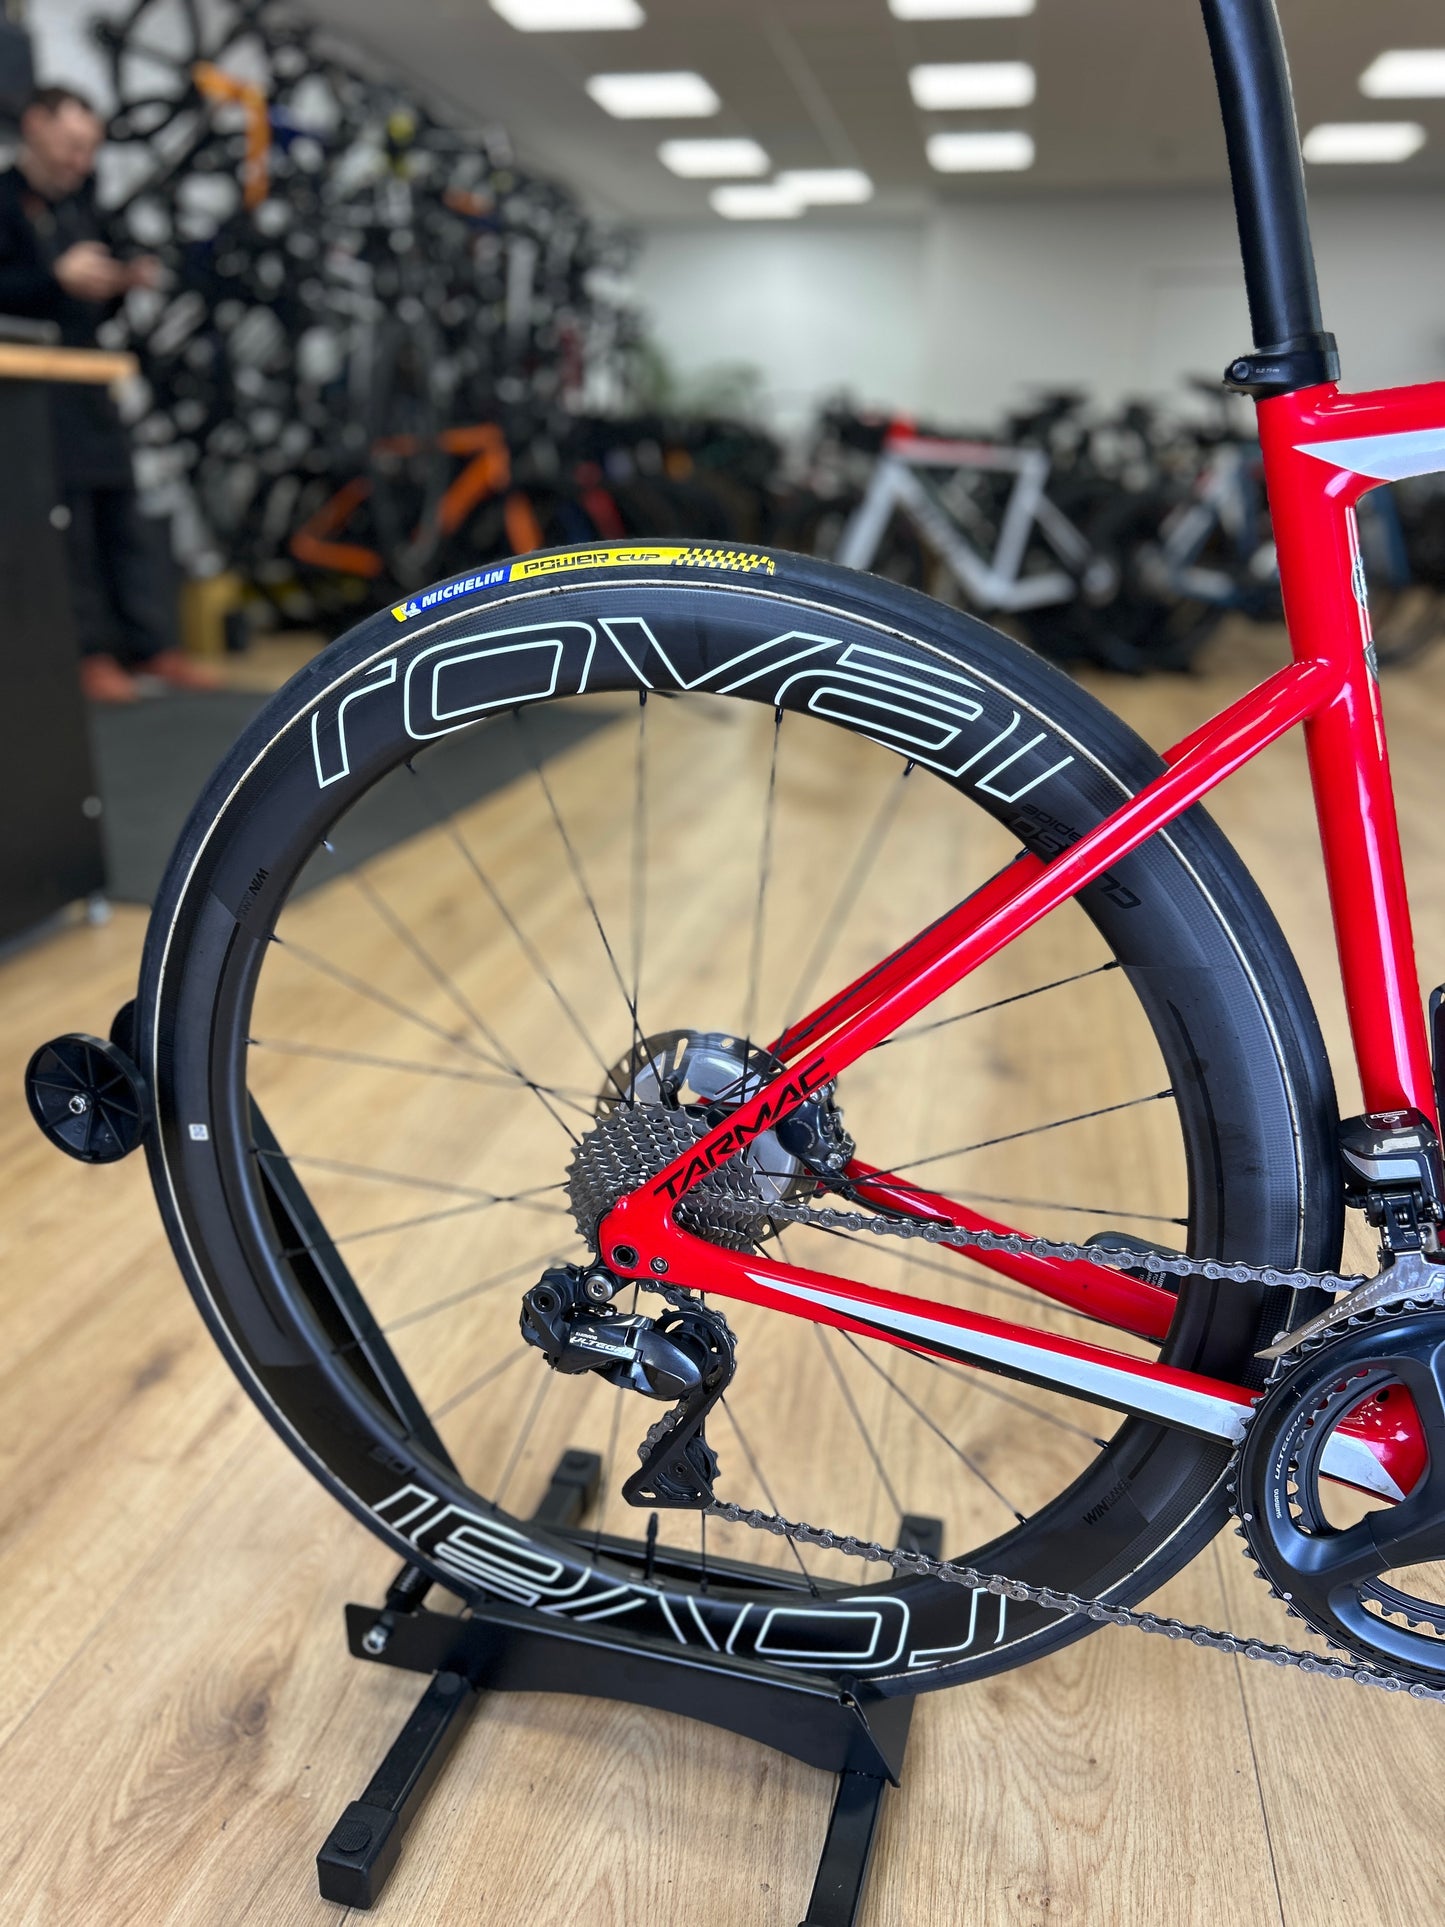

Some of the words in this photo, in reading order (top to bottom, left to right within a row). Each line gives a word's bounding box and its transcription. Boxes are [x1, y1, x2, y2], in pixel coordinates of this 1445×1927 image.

[422, 569, 505, 608] MICHELIN
[524, 553, 609, 574] POWER
[615, 553, 661, 563] CUP
[653, 1057, 830, 1200] TARMAC
[1328, 1272, 1395, 1319] ULTEGRA
[1274, 1411, 1305, 1480] ULTEGRA
